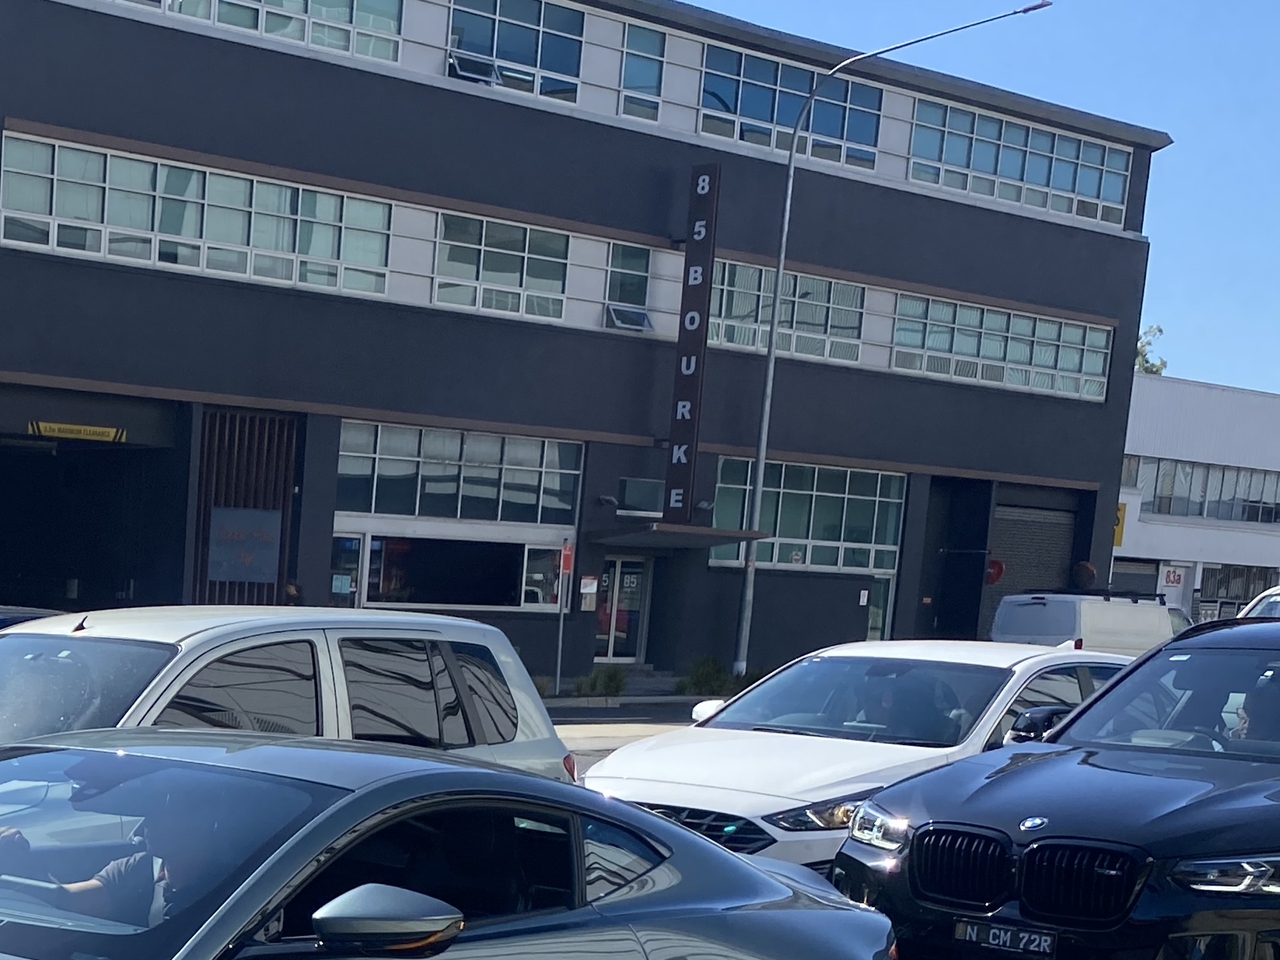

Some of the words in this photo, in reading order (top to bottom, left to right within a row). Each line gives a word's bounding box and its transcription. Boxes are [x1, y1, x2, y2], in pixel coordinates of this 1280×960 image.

[670, 266, 703, 508] BOURKE
[602, 574, 609, 586] 5
[623, 575, 637, 587] 85
[1165, 570, 1182, 585] 83a
[966, 925, 977, 942] N
[989, 929, 1011, 947] CM
[1019, 933, 1051, 953] 72R
